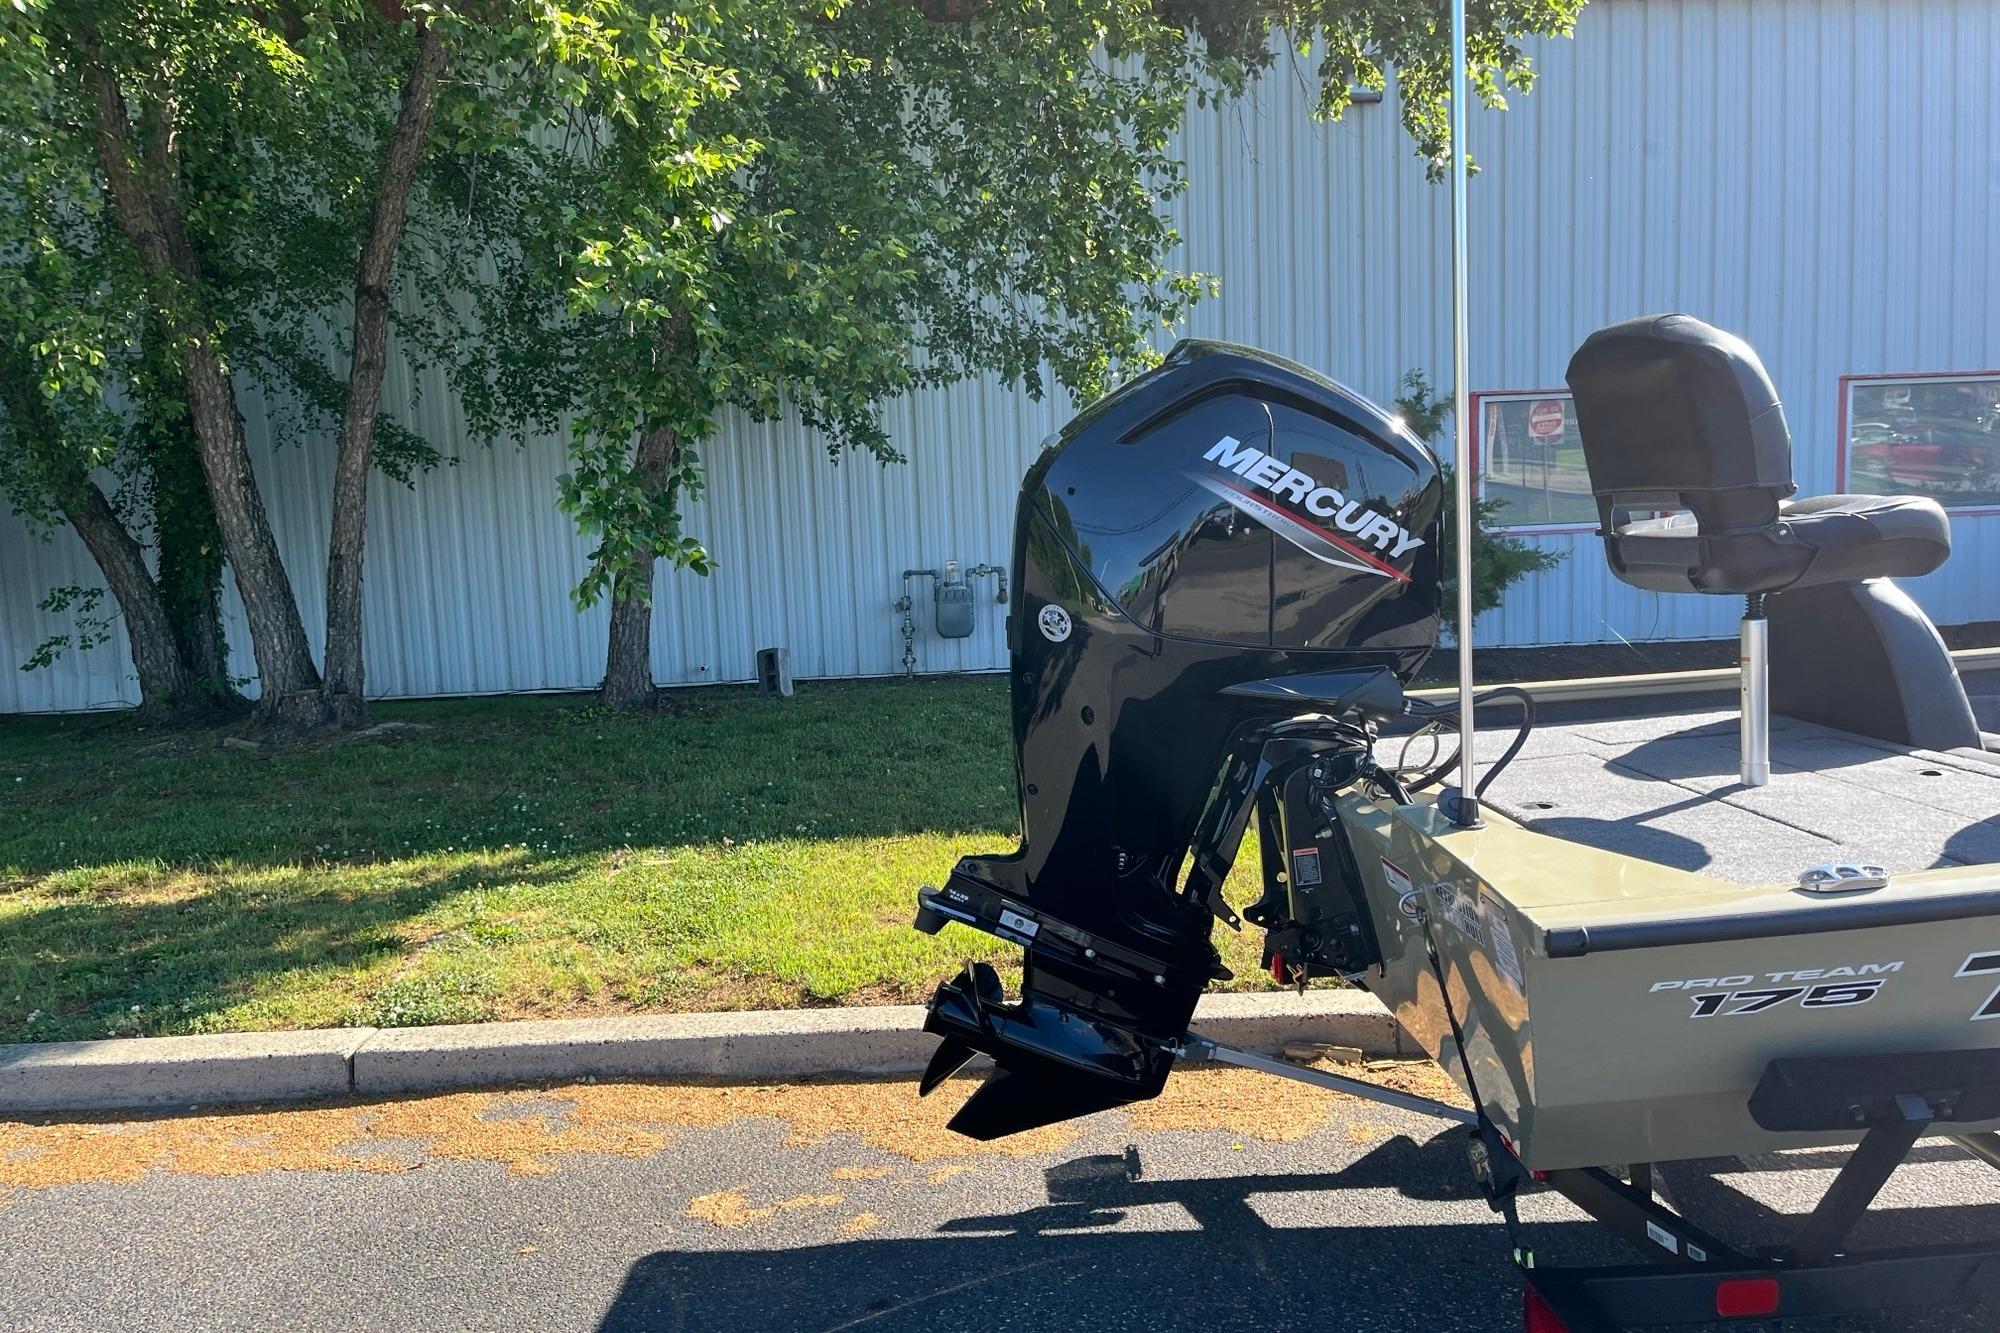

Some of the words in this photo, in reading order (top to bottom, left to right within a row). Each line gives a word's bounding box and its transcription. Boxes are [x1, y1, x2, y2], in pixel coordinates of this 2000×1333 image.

[1202, 435, 1426, 559] MERCURY
[1648, 975, 1755, 993] PRO
[1764, 961, 1905, 983] TEAM
[1689, 978, 1888, 1019] 175
